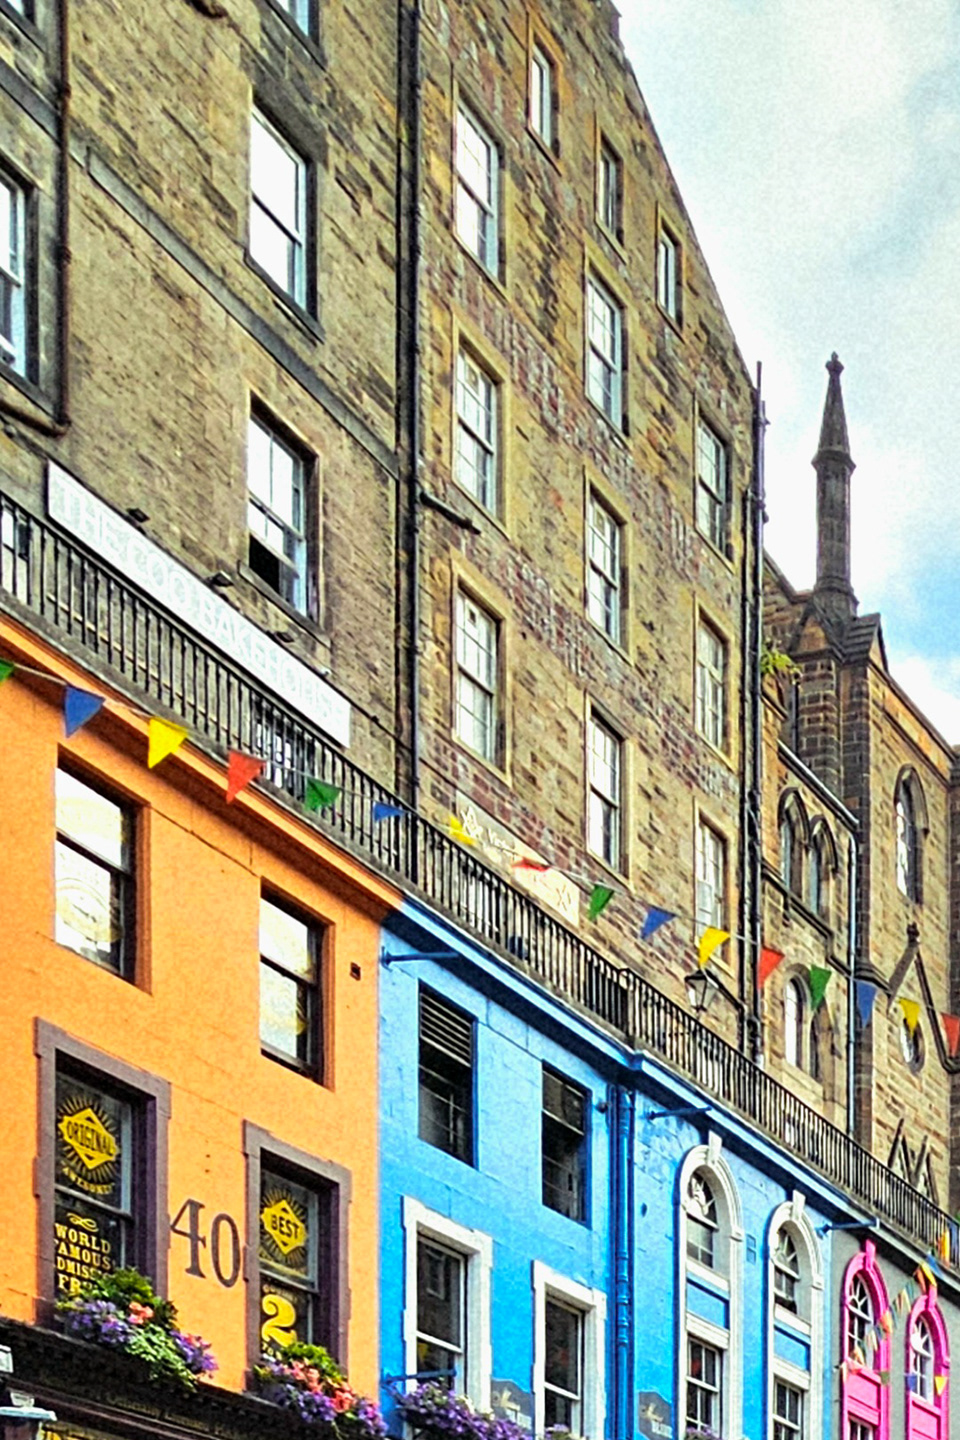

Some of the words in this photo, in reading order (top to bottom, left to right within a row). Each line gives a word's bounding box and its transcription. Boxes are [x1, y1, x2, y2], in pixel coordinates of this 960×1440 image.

[66, 1120, 114, 1157] ORIGINAL
[55, 1223, 111, 1254] WORLD
[170, 1198, 240, 1288] 40
[270, 1214, 301, 1239] BEST
[262, 1294, 298, 1348] 2
